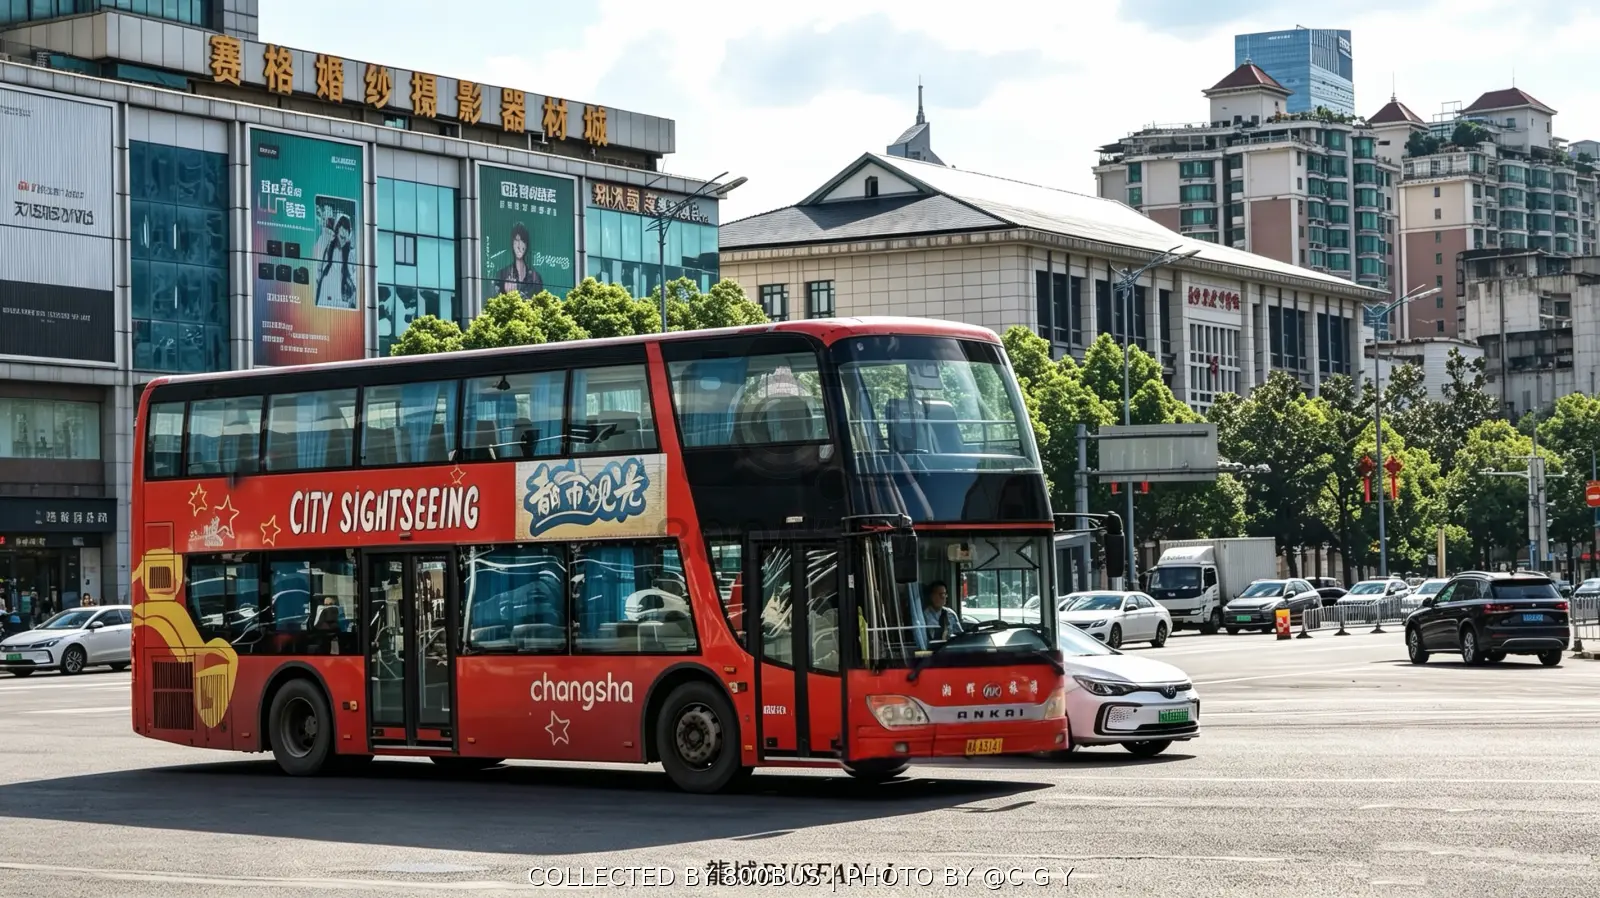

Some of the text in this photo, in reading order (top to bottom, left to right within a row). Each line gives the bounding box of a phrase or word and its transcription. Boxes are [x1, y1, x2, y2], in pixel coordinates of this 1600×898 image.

[208, 34, 608, 148] 赛格婚纱摄影器材城
[289, 485, 480, 535] CITY SIGHTSEEING
[526, 459, 647, 531] 都市观光
[530, 672, 633, 711] changsha
[957, 708, 1024, 720] ANKAI
